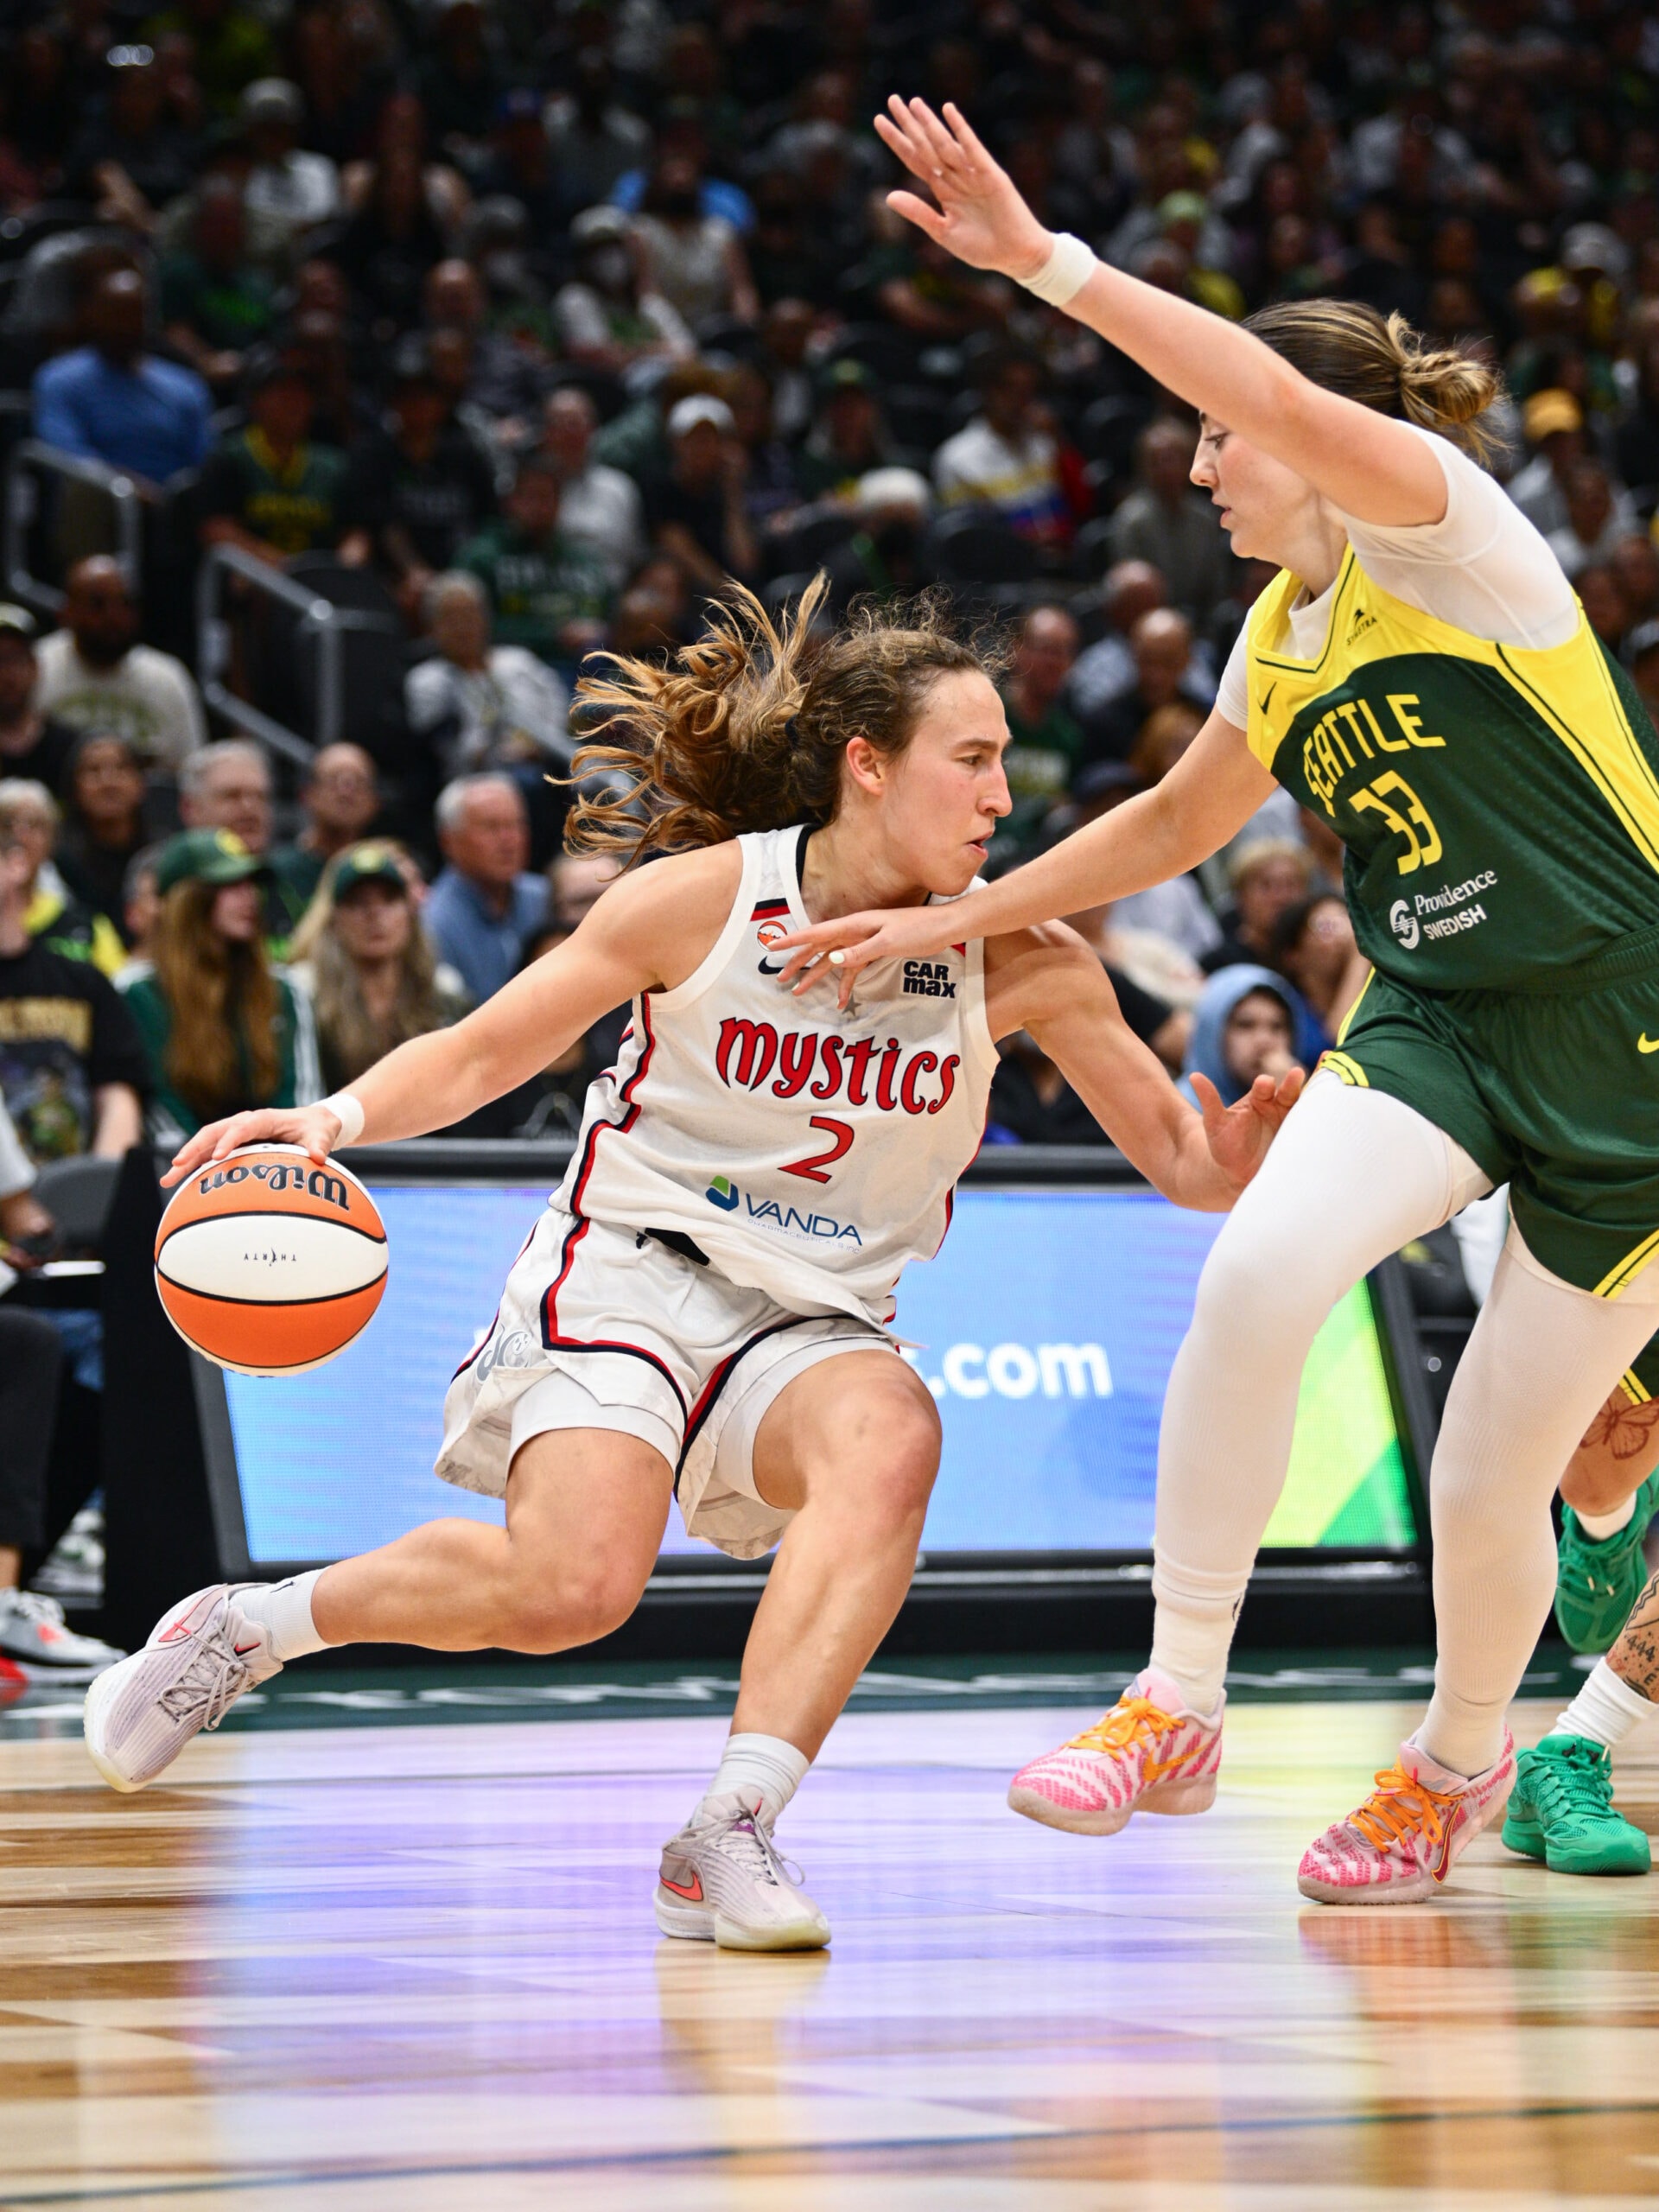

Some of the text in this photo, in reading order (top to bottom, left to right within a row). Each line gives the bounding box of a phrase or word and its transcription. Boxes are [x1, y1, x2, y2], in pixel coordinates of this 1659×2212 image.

[1304, 694, 1446, 817] SEATTLE
[1348, 769, 1443, 875] 33
[1414, 870, 1498, 916] Providence
[1422, 904, 1487, 940] SWEDISH
[902, 976, 957, 999] max
[903, 960, 950, 982] CAR
[776, 1116, 855, 1184] 2
[199, 1163, 350, 1211] Wilson
[746, 1192, 862, 1246] VANDA
